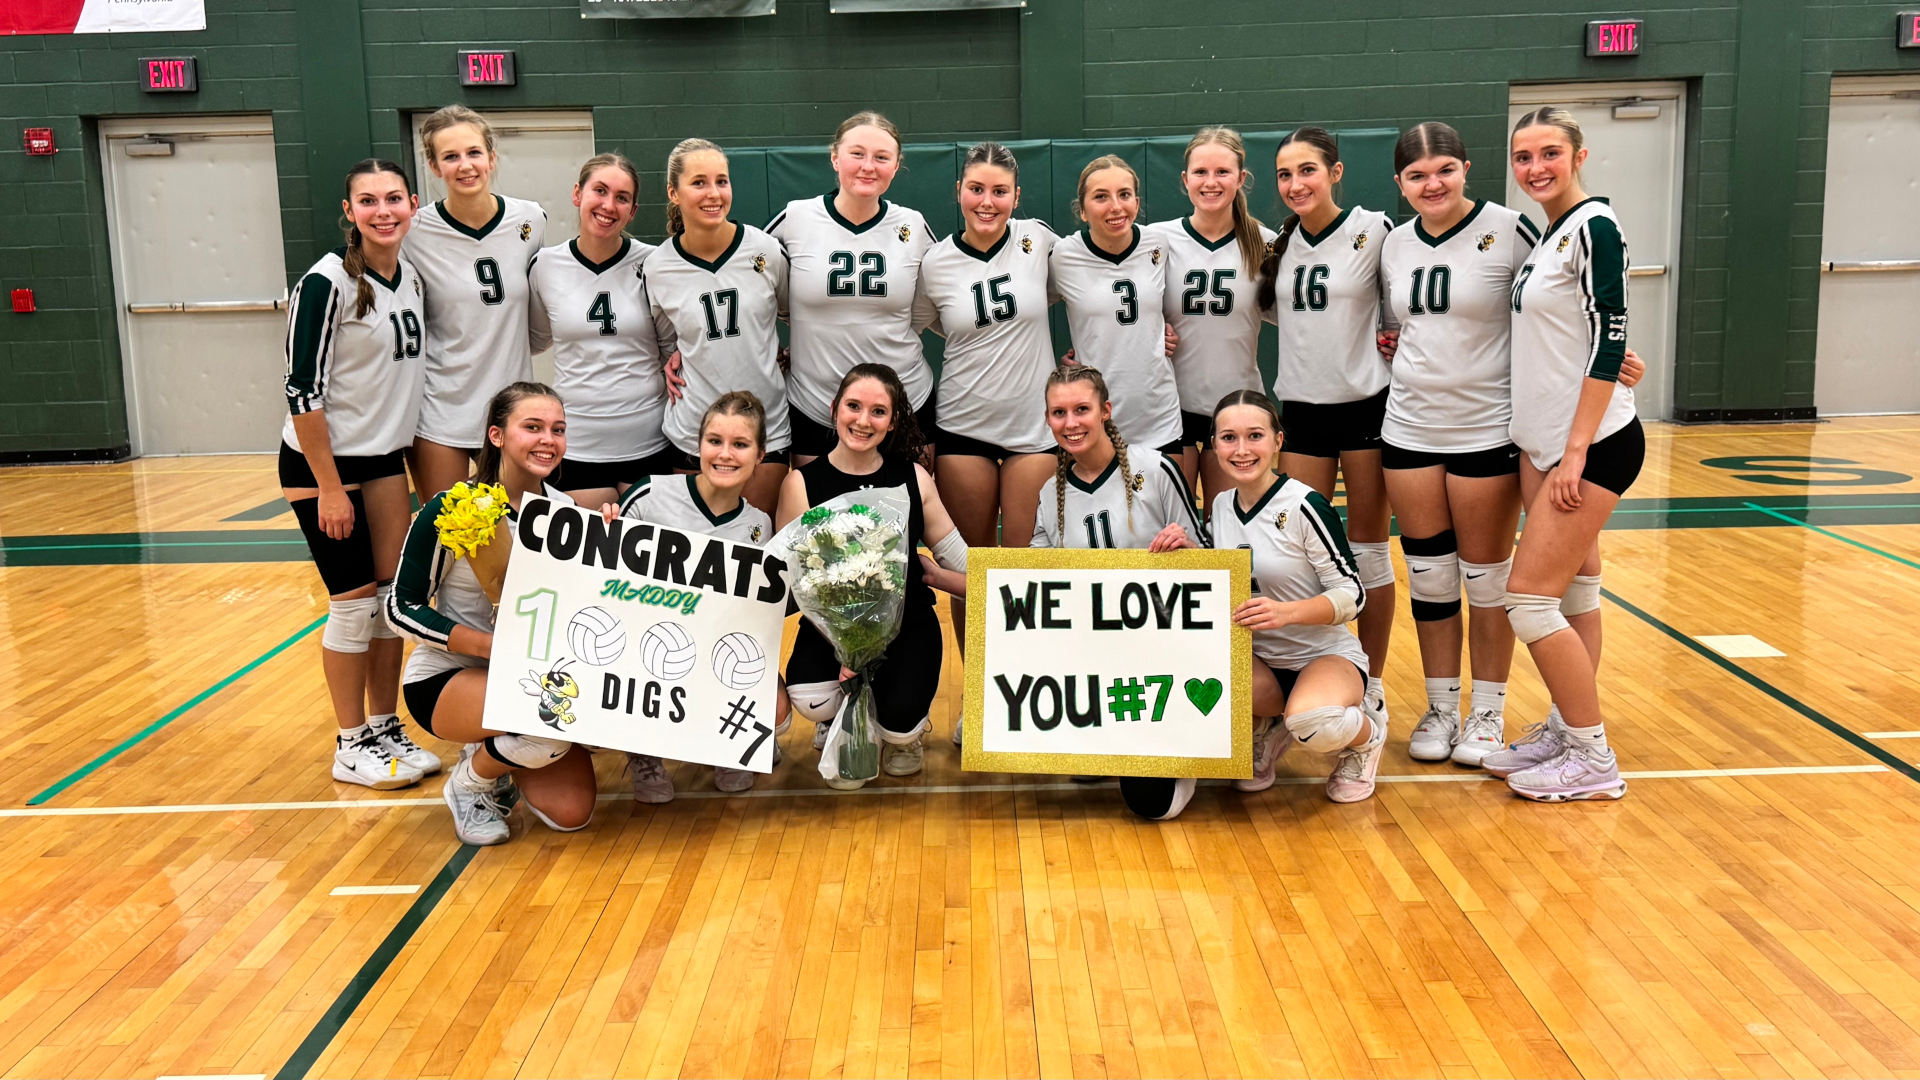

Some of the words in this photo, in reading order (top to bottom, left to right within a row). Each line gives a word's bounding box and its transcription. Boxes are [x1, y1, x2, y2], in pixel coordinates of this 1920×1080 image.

[1599, 23, 1637, 52] EXIT
[148, 60, 185, 88] EXIT
[468, 54, 504, 82] EXIT
[474, 257, 505, 305] 9
[826, 250, 888, 298] 22
[1182, 268, 1237, 316] 25
[1292, 264, 1330, 311] 16
[1408, 265, 1451, 315] 10
[586, 291, 617, 336] 4
[699, 288, 740, 341] 17
[972, 273, 1018, 329] 15
[1112, 279, 1139, 325] 3
[389, 310, 421, 361] 19
[518, 499, 789, 604] CONGRATS
[1083, 509, 1117, 549] 11
[600, 578, 702, 615] MADDY
[999, 581, 1072, 631] WE
[1092, 582, 1214, 630] LOVE
[602, 672, 686, 723] DIGS
[993, 673, 1102, 731] YOU
[1107, 675, 1174, 722] #7
[718, 695, 773, 767] #7
